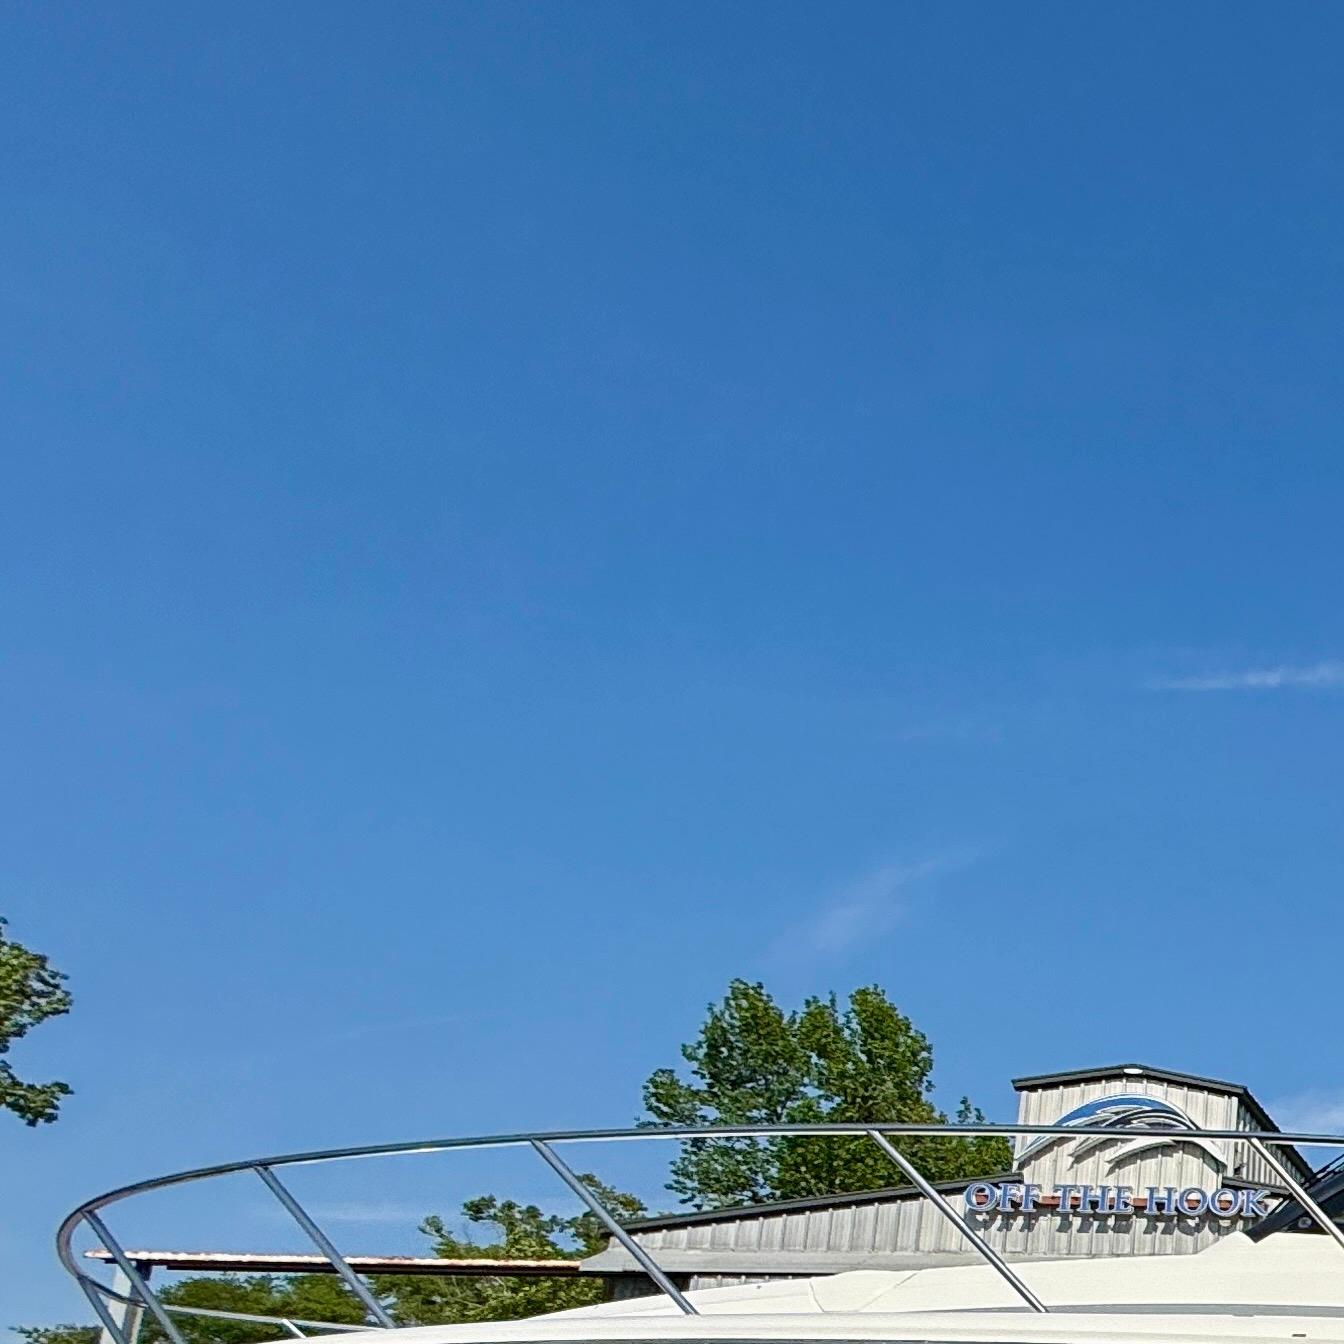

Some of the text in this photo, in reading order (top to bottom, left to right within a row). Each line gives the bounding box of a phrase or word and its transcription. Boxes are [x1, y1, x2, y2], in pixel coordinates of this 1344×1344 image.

[964, 1182, 1271, 1219] OFF THE HOOK
